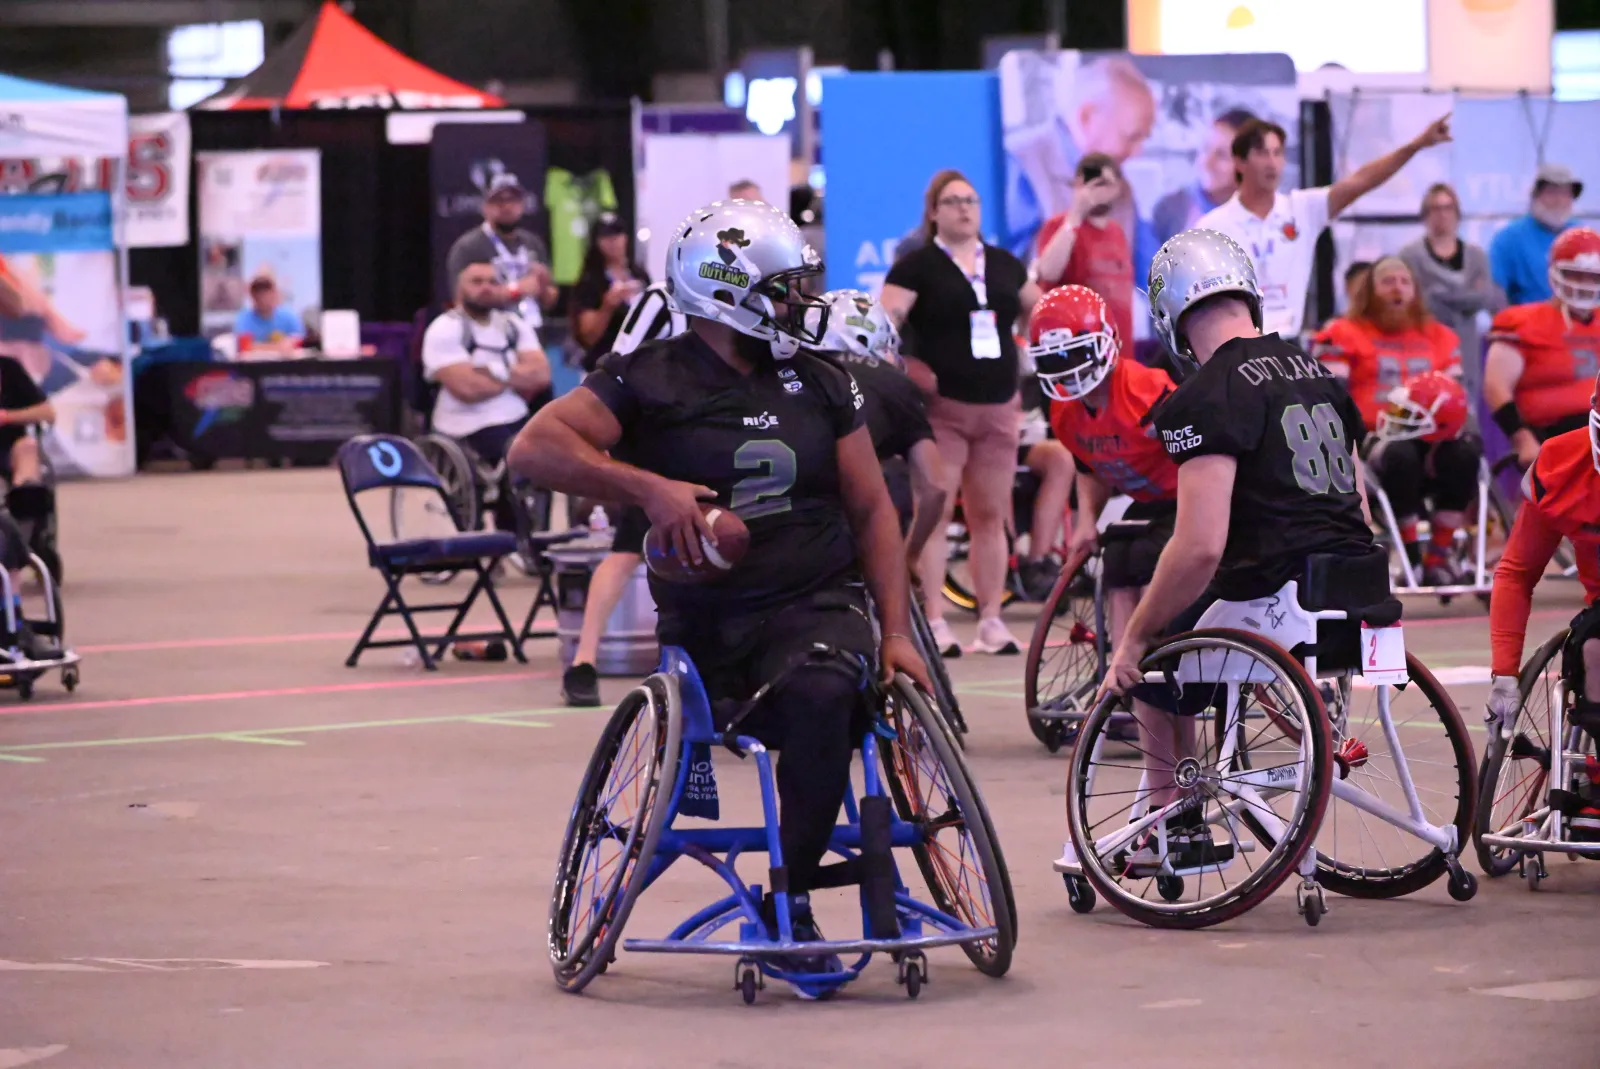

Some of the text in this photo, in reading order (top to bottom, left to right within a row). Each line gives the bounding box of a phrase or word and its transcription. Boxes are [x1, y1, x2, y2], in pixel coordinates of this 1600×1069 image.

[700, 262, 749, 288] OUTLAWS
[743, 411, 779, 430] RISE
[1281, 403, 1355, 495] 88
[730, 440, 797, 520] 2
[1369, 634, 1376, 666] 2
